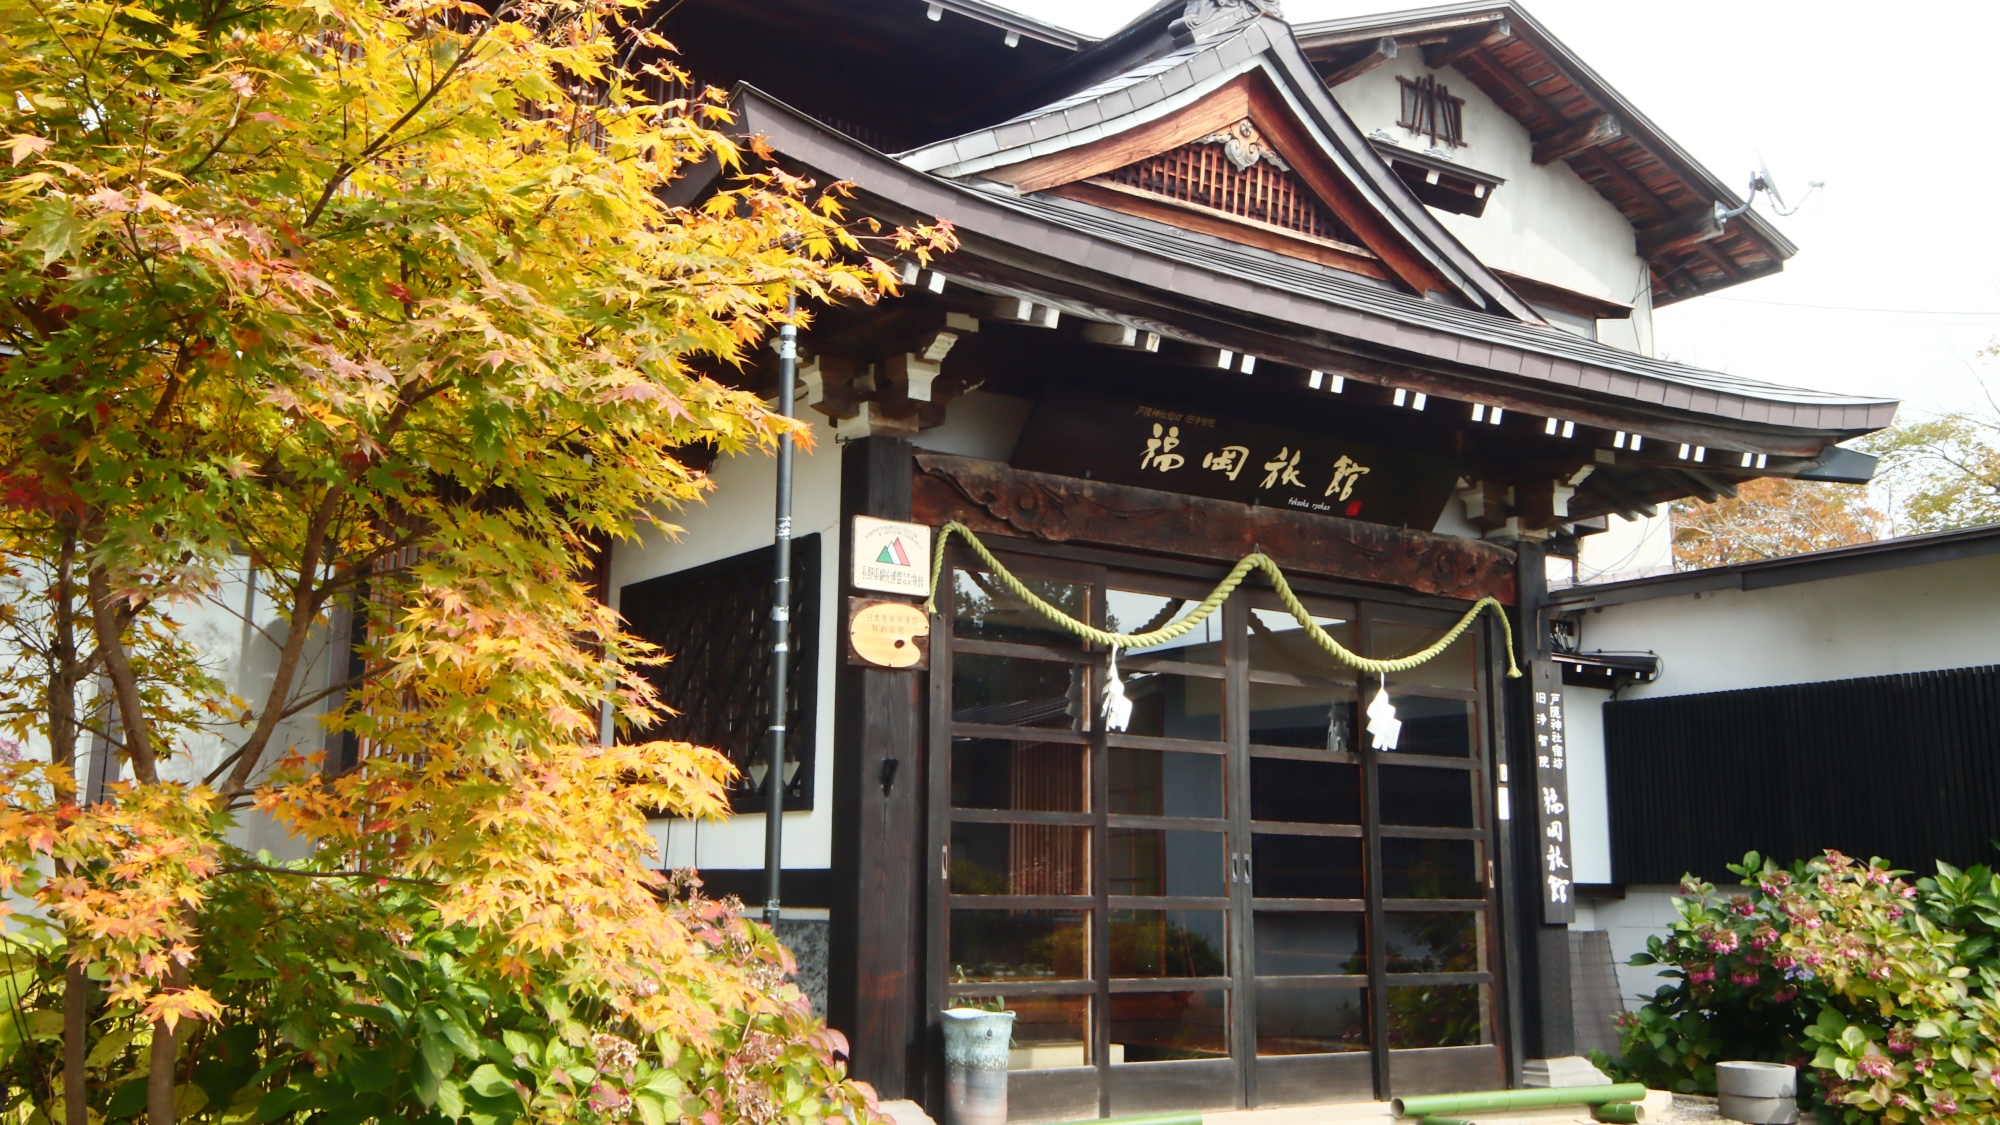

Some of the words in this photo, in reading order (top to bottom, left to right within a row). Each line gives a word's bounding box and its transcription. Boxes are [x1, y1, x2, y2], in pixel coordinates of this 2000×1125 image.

[1140, 422, 1371, 502] 福岡旅館
[1287, 496, 1310, 508] fukuoka
[1312, 502, 1331, 512] ryokan
[1535, 691, 1550, 769] 旧浄智院
[1549, 692, 1564, 770] 戸隠神社宿坊
[1542, 786, 1570, 904] 福岡旅館
